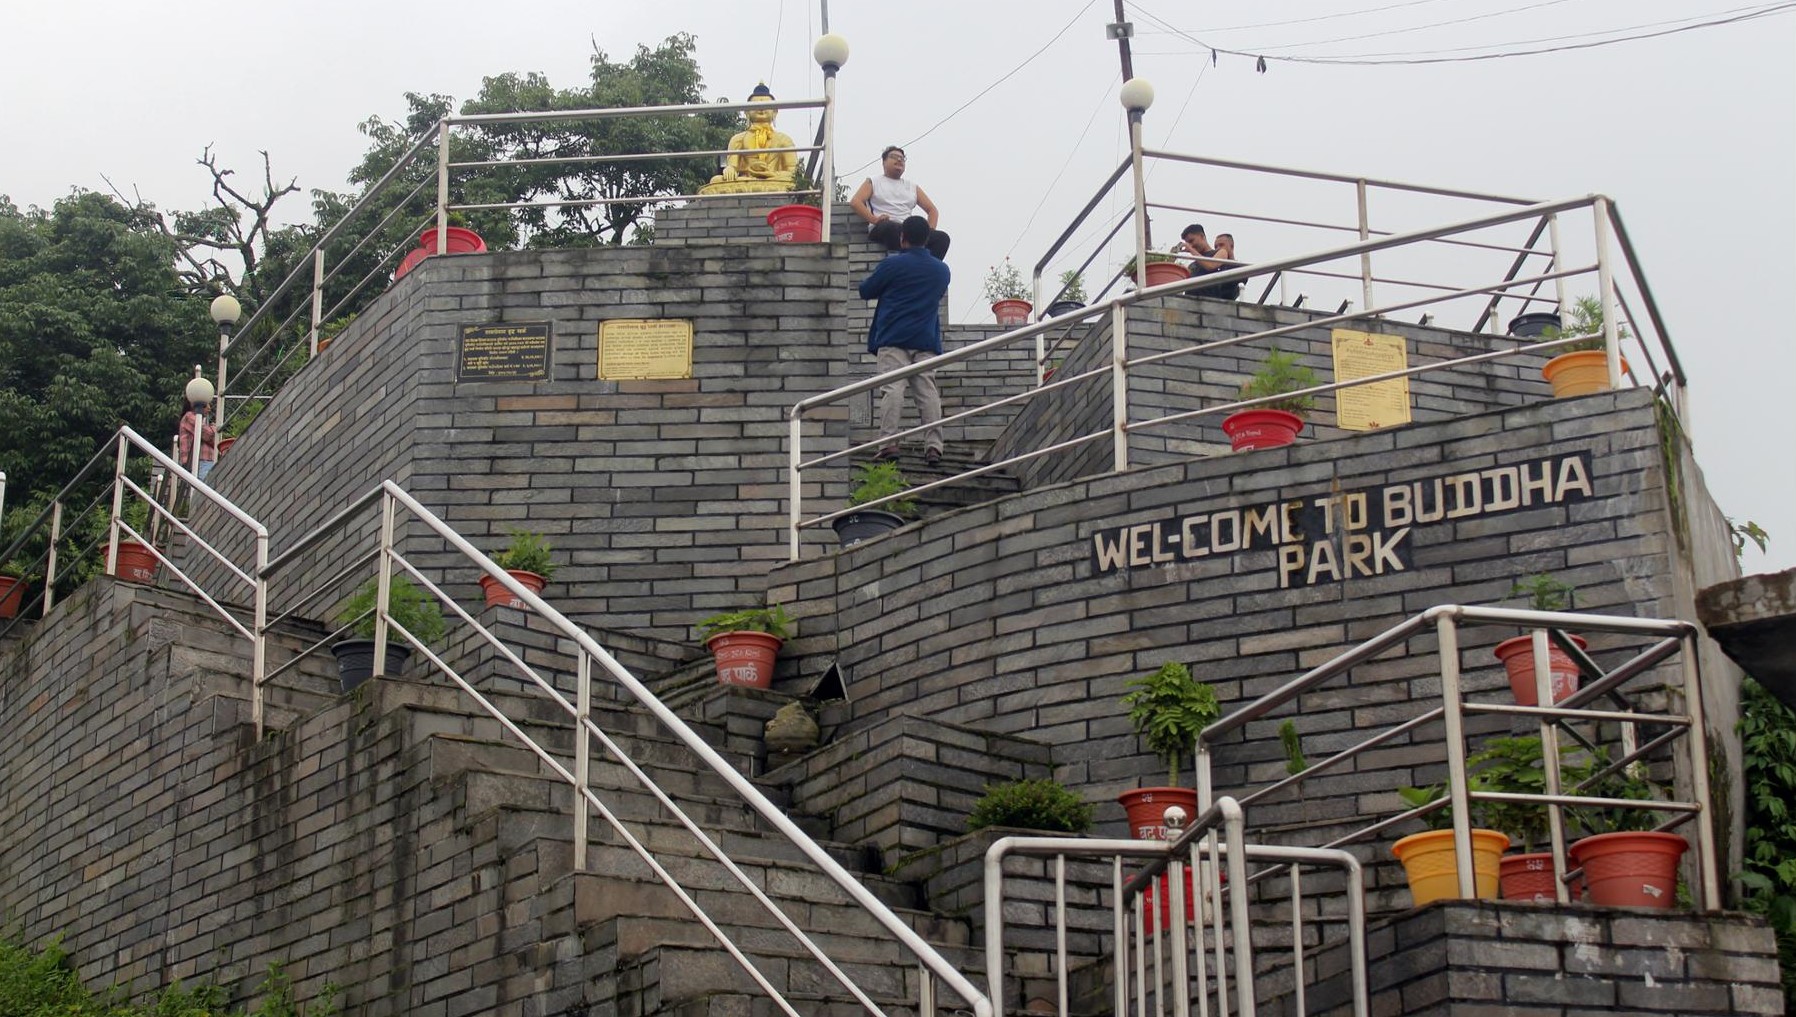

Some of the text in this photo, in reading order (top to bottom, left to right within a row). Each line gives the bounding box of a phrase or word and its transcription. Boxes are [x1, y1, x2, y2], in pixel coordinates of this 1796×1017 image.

[1094, 455, 1593, 572] WEL-COME TO BUDDHA
[1279, 527, 1411, 589] PARK
